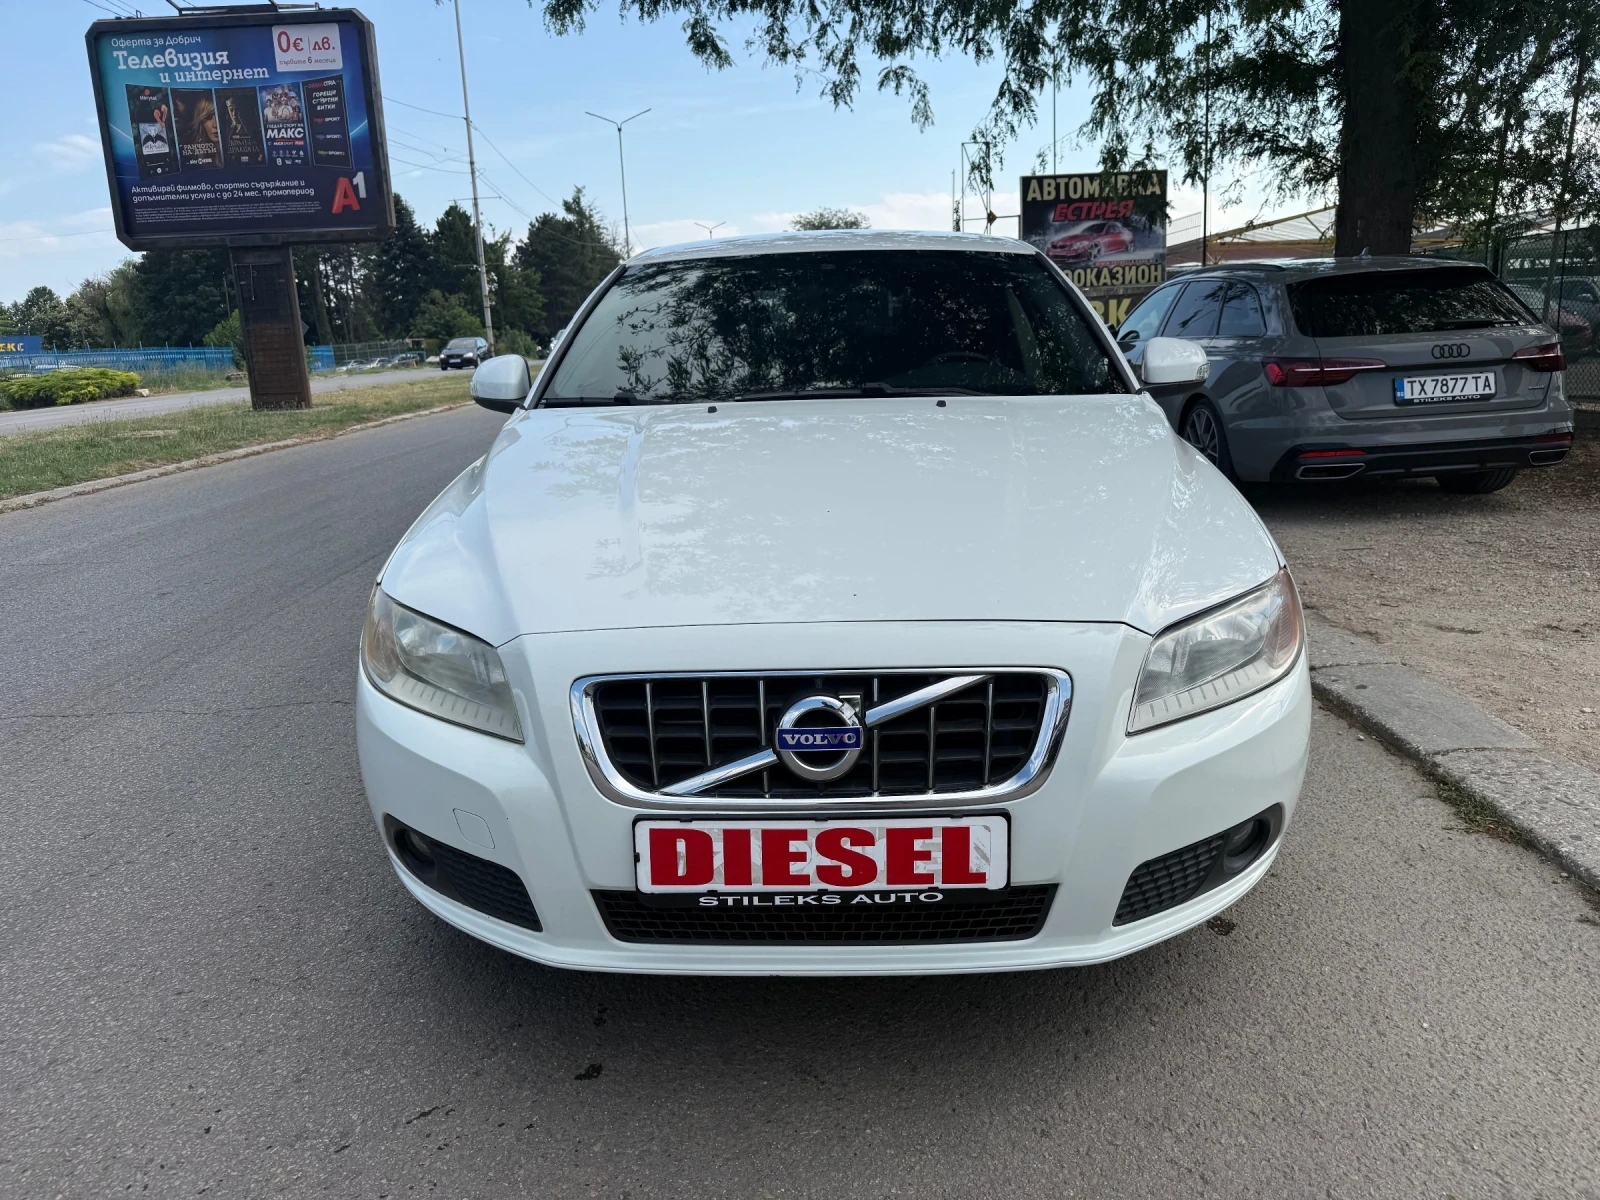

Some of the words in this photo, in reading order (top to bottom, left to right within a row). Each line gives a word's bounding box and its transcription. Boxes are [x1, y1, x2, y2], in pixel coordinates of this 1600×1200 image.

[111, 37, 151, 48] Оферта
[153, 38, 164, 47] за
[166, 35, 201, 46] Добрич
[312, 36, 335, 50] лв.
[113, 48, 229, 70] Телевизия
[307, 56, 313, 64] 6
[159, 73, 171, 83] и
[174, 67, 269, 83] интернет
[266, 128, 304, 139] МАКС
[131, 184, 176, 194] Активирай
[214, 182, 249, 191] спортно
[250, 180, 299, 190] съдържание
[132, 193, 190, 203] допълнителни
[190, 191, 215, 201] услуги
[222, 191, 232, 200] до
[233, 190, 243, 198] 24
[262, 187, 315, 198] промопериод
[1026, 173, 1162, 201] АВТОМВКА
[1052, 200, 1135, 222] ЕСТРЕЯ
[1406, 379, 1428, 397] TX
[1430, 376, 1468, 395] 7877
[1471, 375, 1492, 392] TA
[782, 732, 858, 745] VOLVO
[648, 826, 987, 887] DIESEL
[698, 893, 850, 907] STILEKS
[850, 891, 944, 905] AUTO
